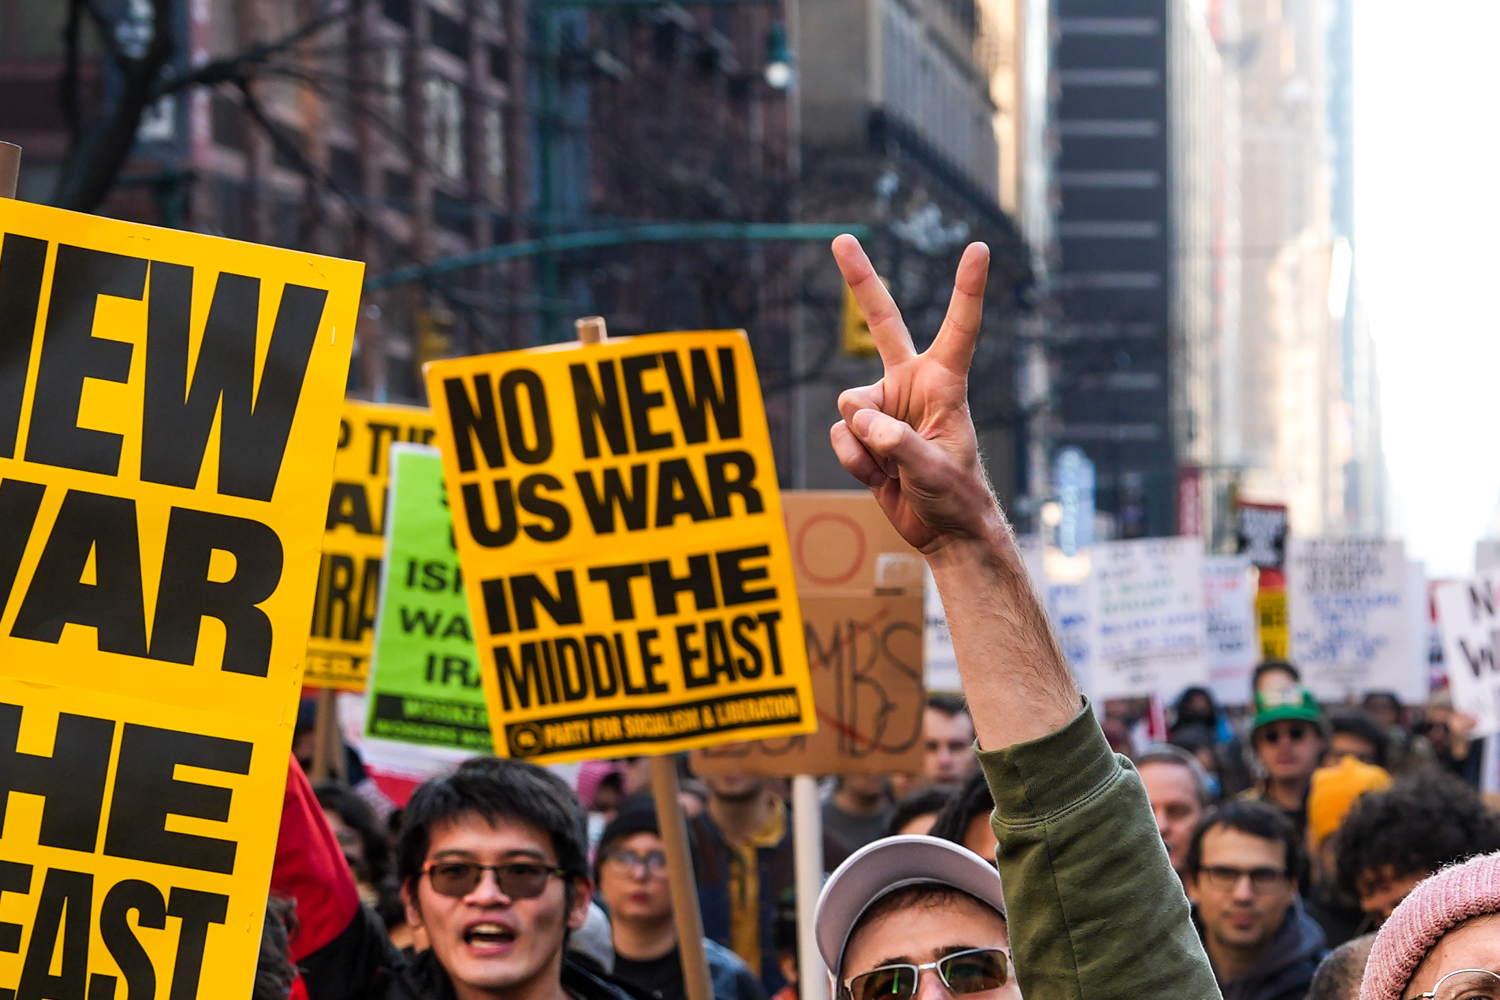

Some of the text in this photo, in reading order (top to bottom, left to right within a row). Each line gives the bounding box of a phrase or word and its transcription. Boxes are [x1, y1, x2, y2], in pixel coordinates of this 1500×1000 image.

[443, 368, 554, 473] NO
[568, 347, 742, 460] NEW
[461, 472, 573, 548] US
[574, 449, 765, 536] WAR
[0, 478, 285, 678] AR
[480, 544, 779, 637] IN THE
[491, 611, 784, 712] MIDDLE EAST
[544, 721, 591, 748] PARTY
[592, 716, 623, 741] FOR
[623, 706, 700, 739] SOCIALISM
[703, 704, 716, 728] &
[715, 694, 799, 727] LIBERATION
